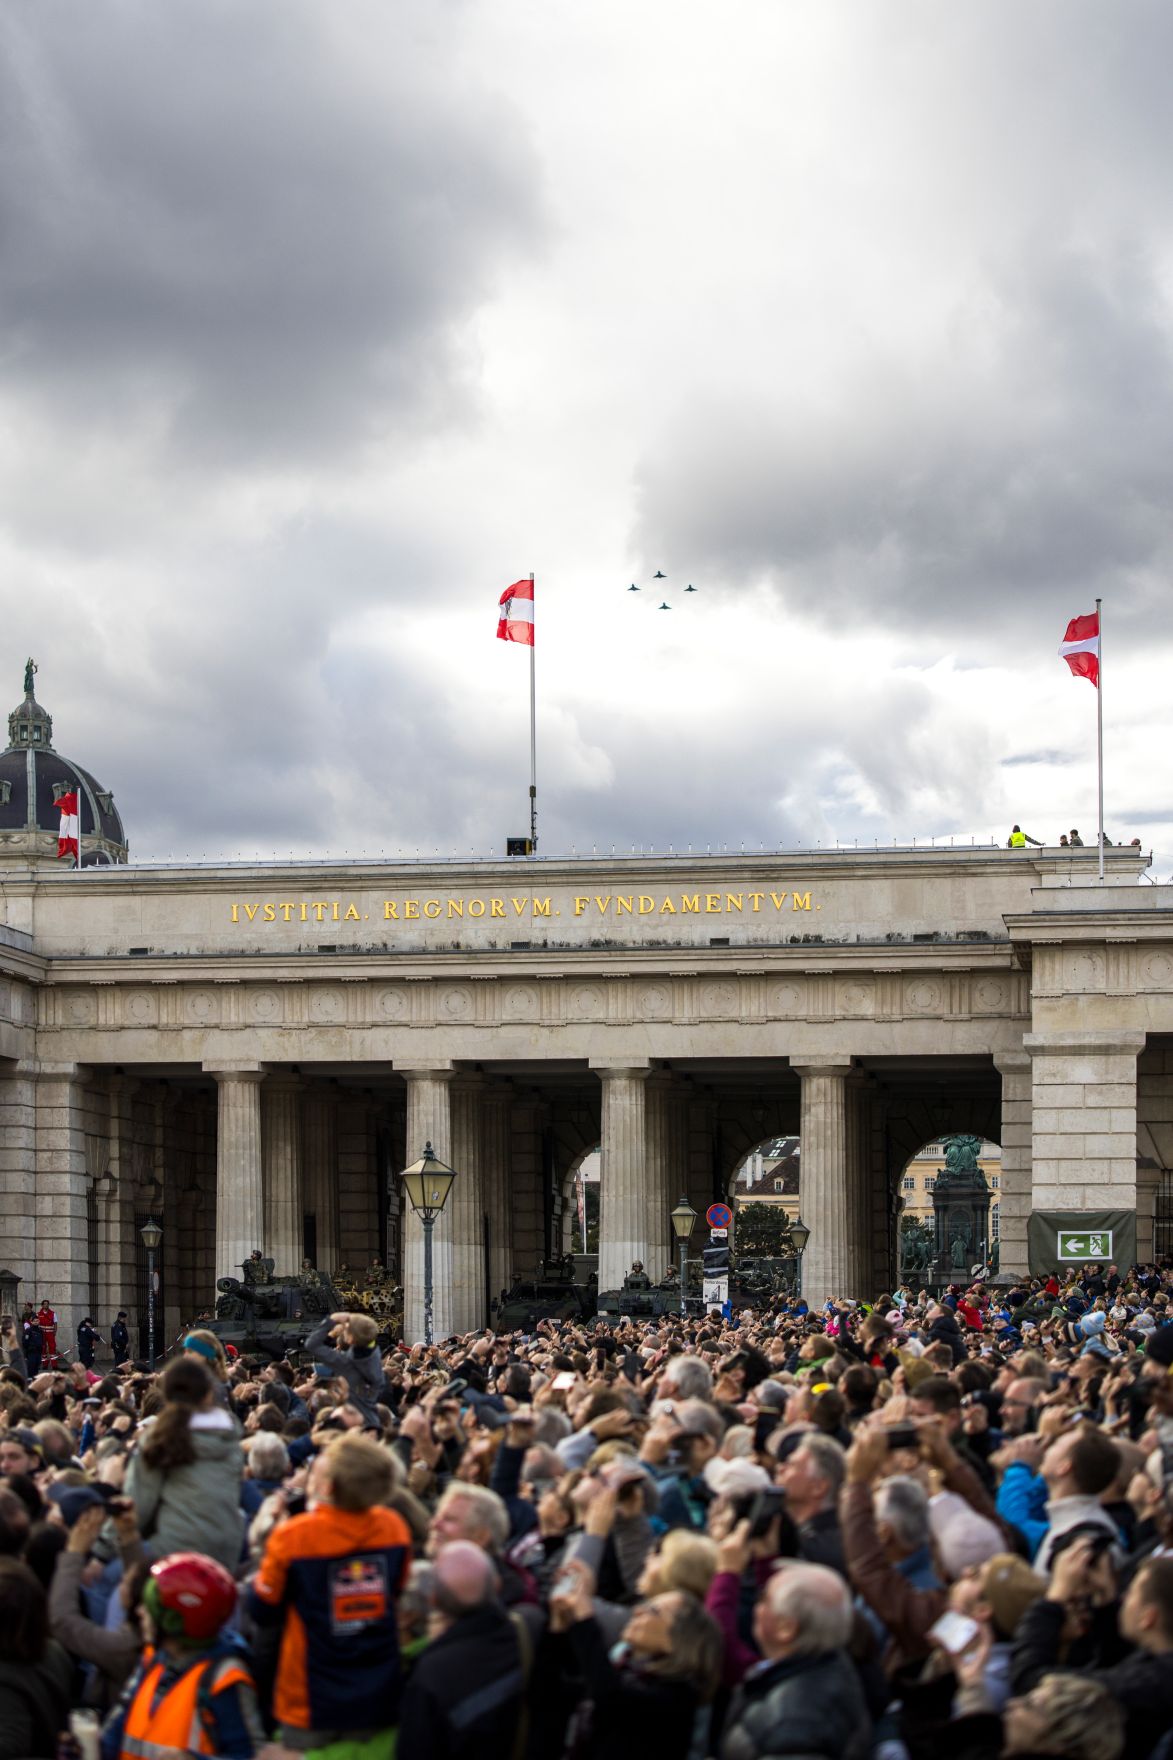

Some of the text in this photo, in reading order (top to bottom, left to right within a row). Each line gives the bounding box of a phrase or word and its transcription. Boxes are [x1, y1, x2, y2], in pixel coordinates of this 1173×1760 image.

[231, 892, 822, 922] IVSTITIA. REGNORVM. FVNDAMENTVM.
